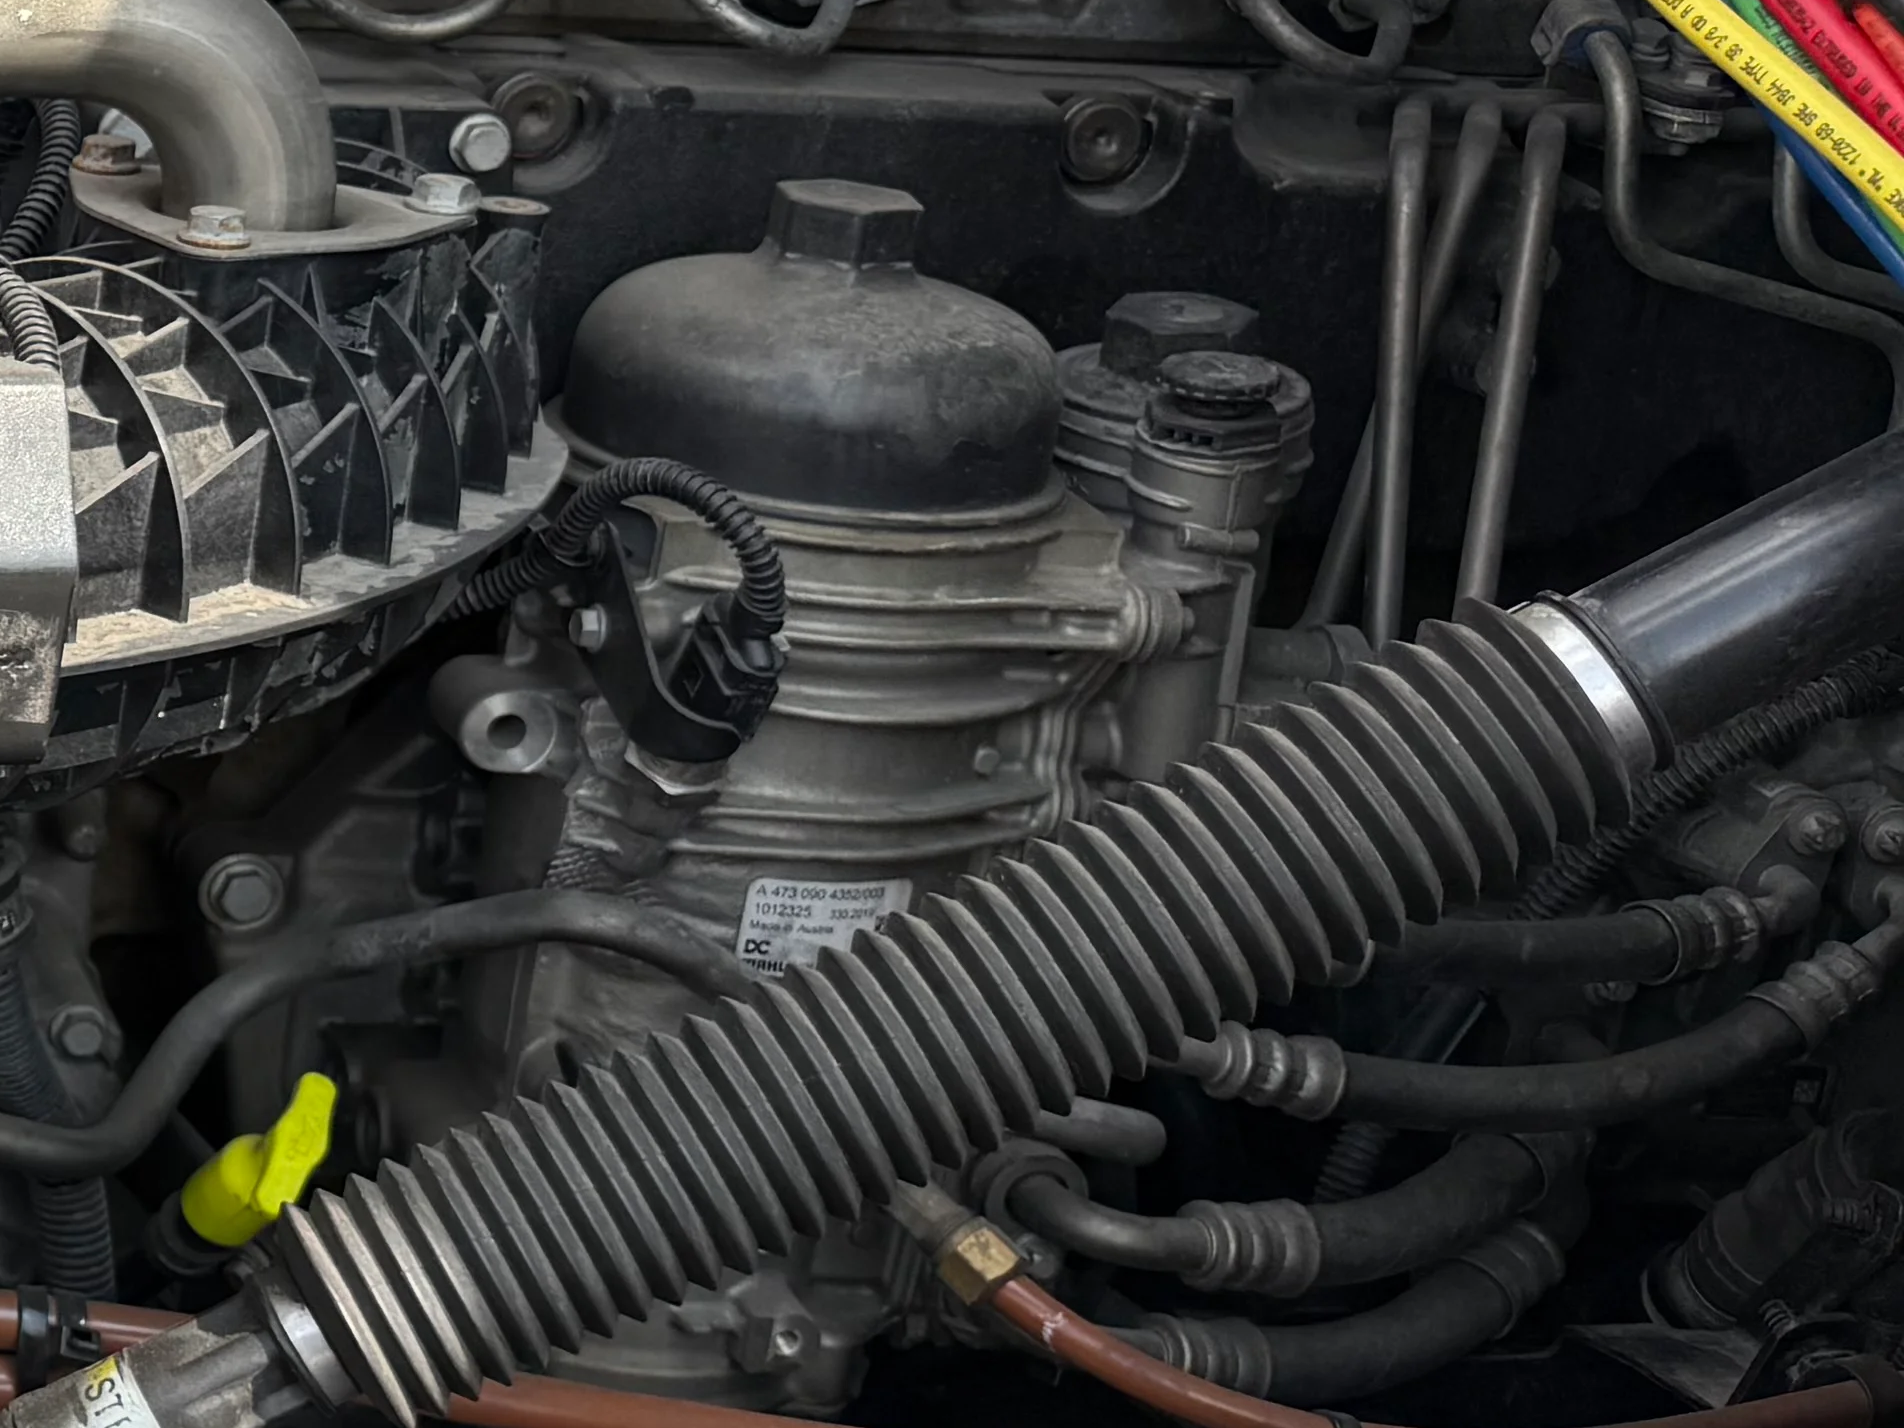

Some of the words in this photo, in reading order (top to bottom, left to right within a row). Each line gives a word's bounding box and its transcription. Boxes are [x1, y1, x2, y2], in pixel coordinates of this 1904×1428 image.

[1738, 55, 1773, 86] TYPE
[1769, 78, 1797, 108] J844
[1792, 101, 1818, 128] SAE
[756, 884, 767, 898] A
[771, 885, 797, 899] 473
[755, 902, 812, 918] 1012325
[750, 920, 778, 933] Made
[743, 939, 771, 955] DC
